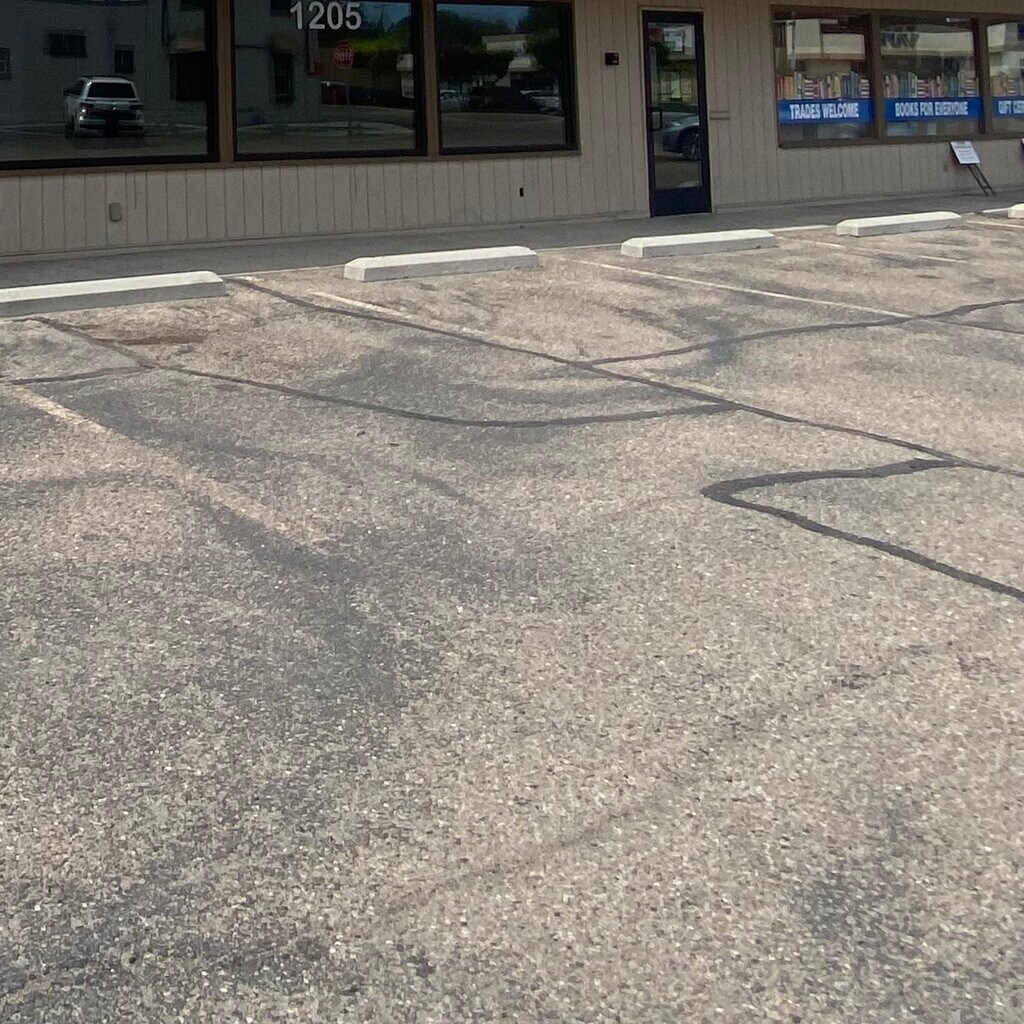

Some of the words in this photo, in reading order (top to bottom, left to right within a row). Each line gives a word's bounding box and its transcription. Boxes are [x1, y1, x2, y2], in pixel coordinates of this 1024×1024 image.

[289, 1, 363, 30] 1205
[789, 103, 821, 120] TRADES
[821, 102, 859, 118] WELCOME
[894, 102, 919, 117] BOOKS
[919, 101, 934, 116] FOR
[934, 101, 968, 116] EVERYONE
